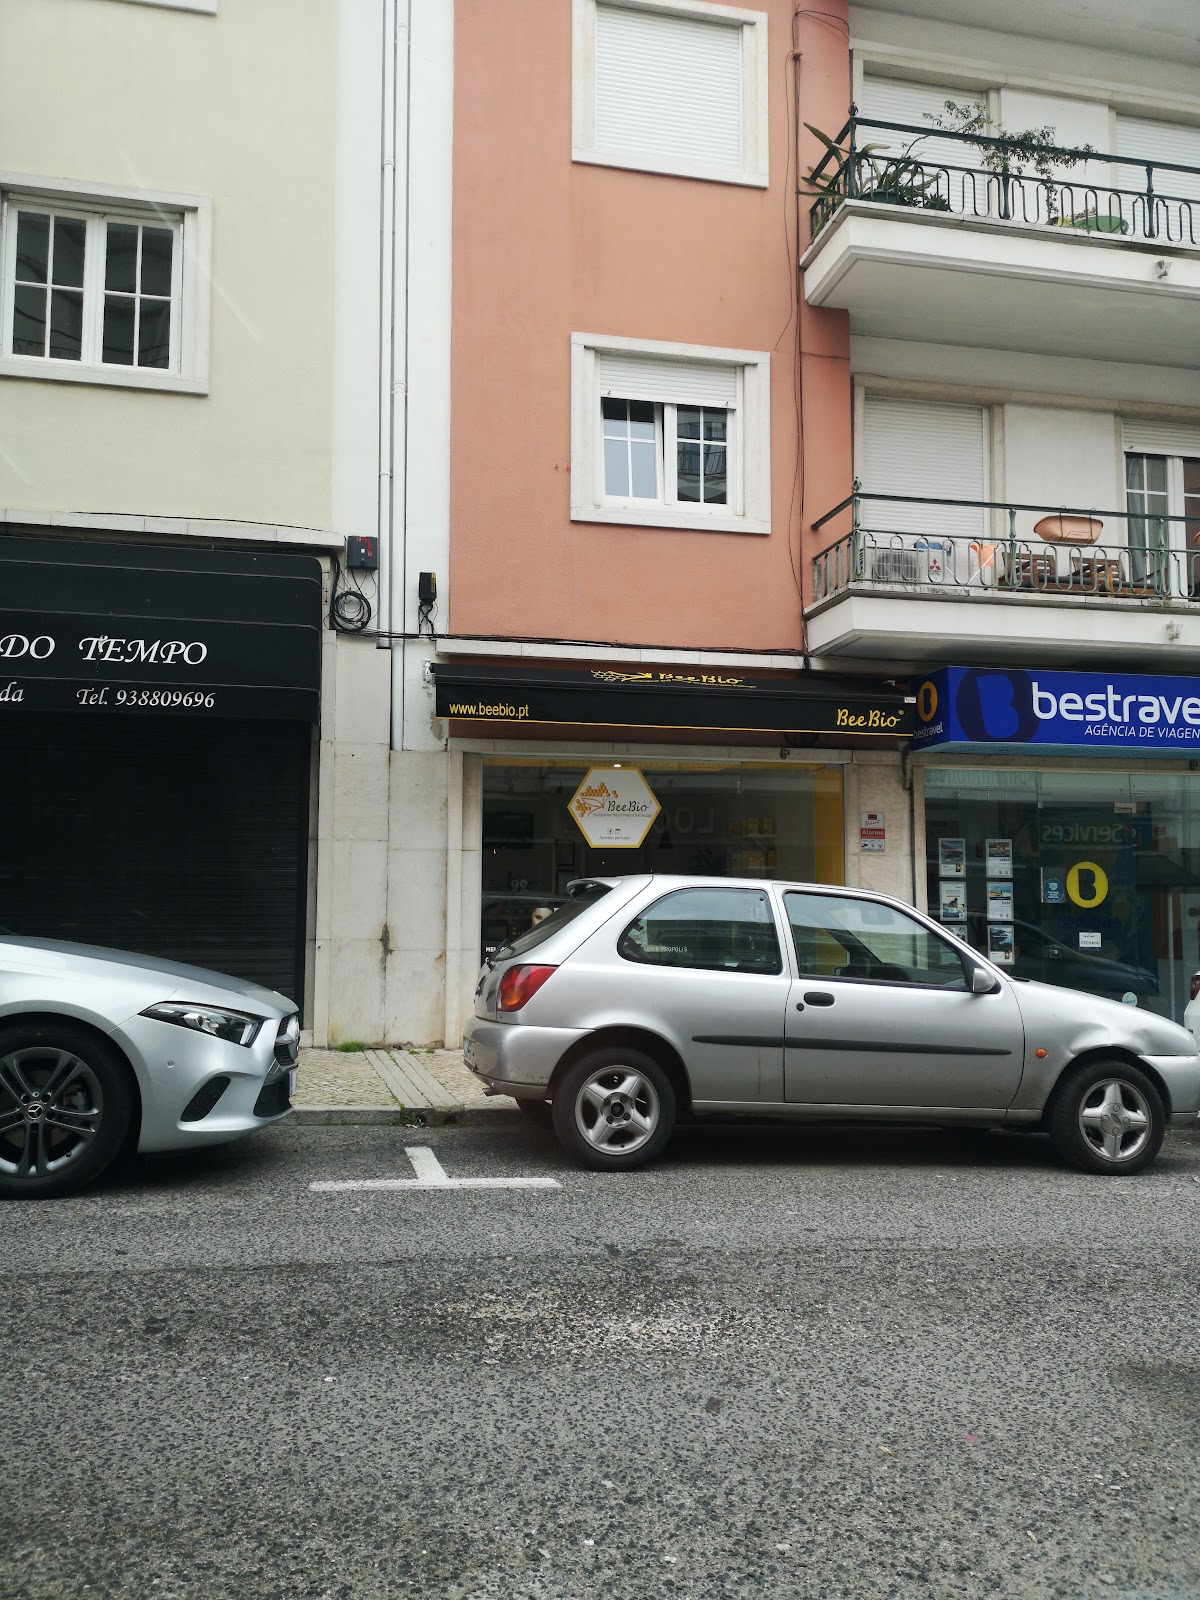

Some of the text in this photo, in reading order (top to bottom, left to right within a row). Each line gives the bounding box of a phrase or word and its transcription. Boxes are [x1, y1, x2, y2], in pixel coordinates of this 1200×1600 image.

[0, 634, 208, 665] DO TEMPO
[76, 687, 109, 705] Tel.
[114, 689, 217, 708] 938809696
[449, 701, 529, 719] www.beebio.pt
[913, 721, 943, 739] bestravel
[1084, 722, 1136, 737] AGÊNCIA
[1138, 726, 1155, 738] DE
